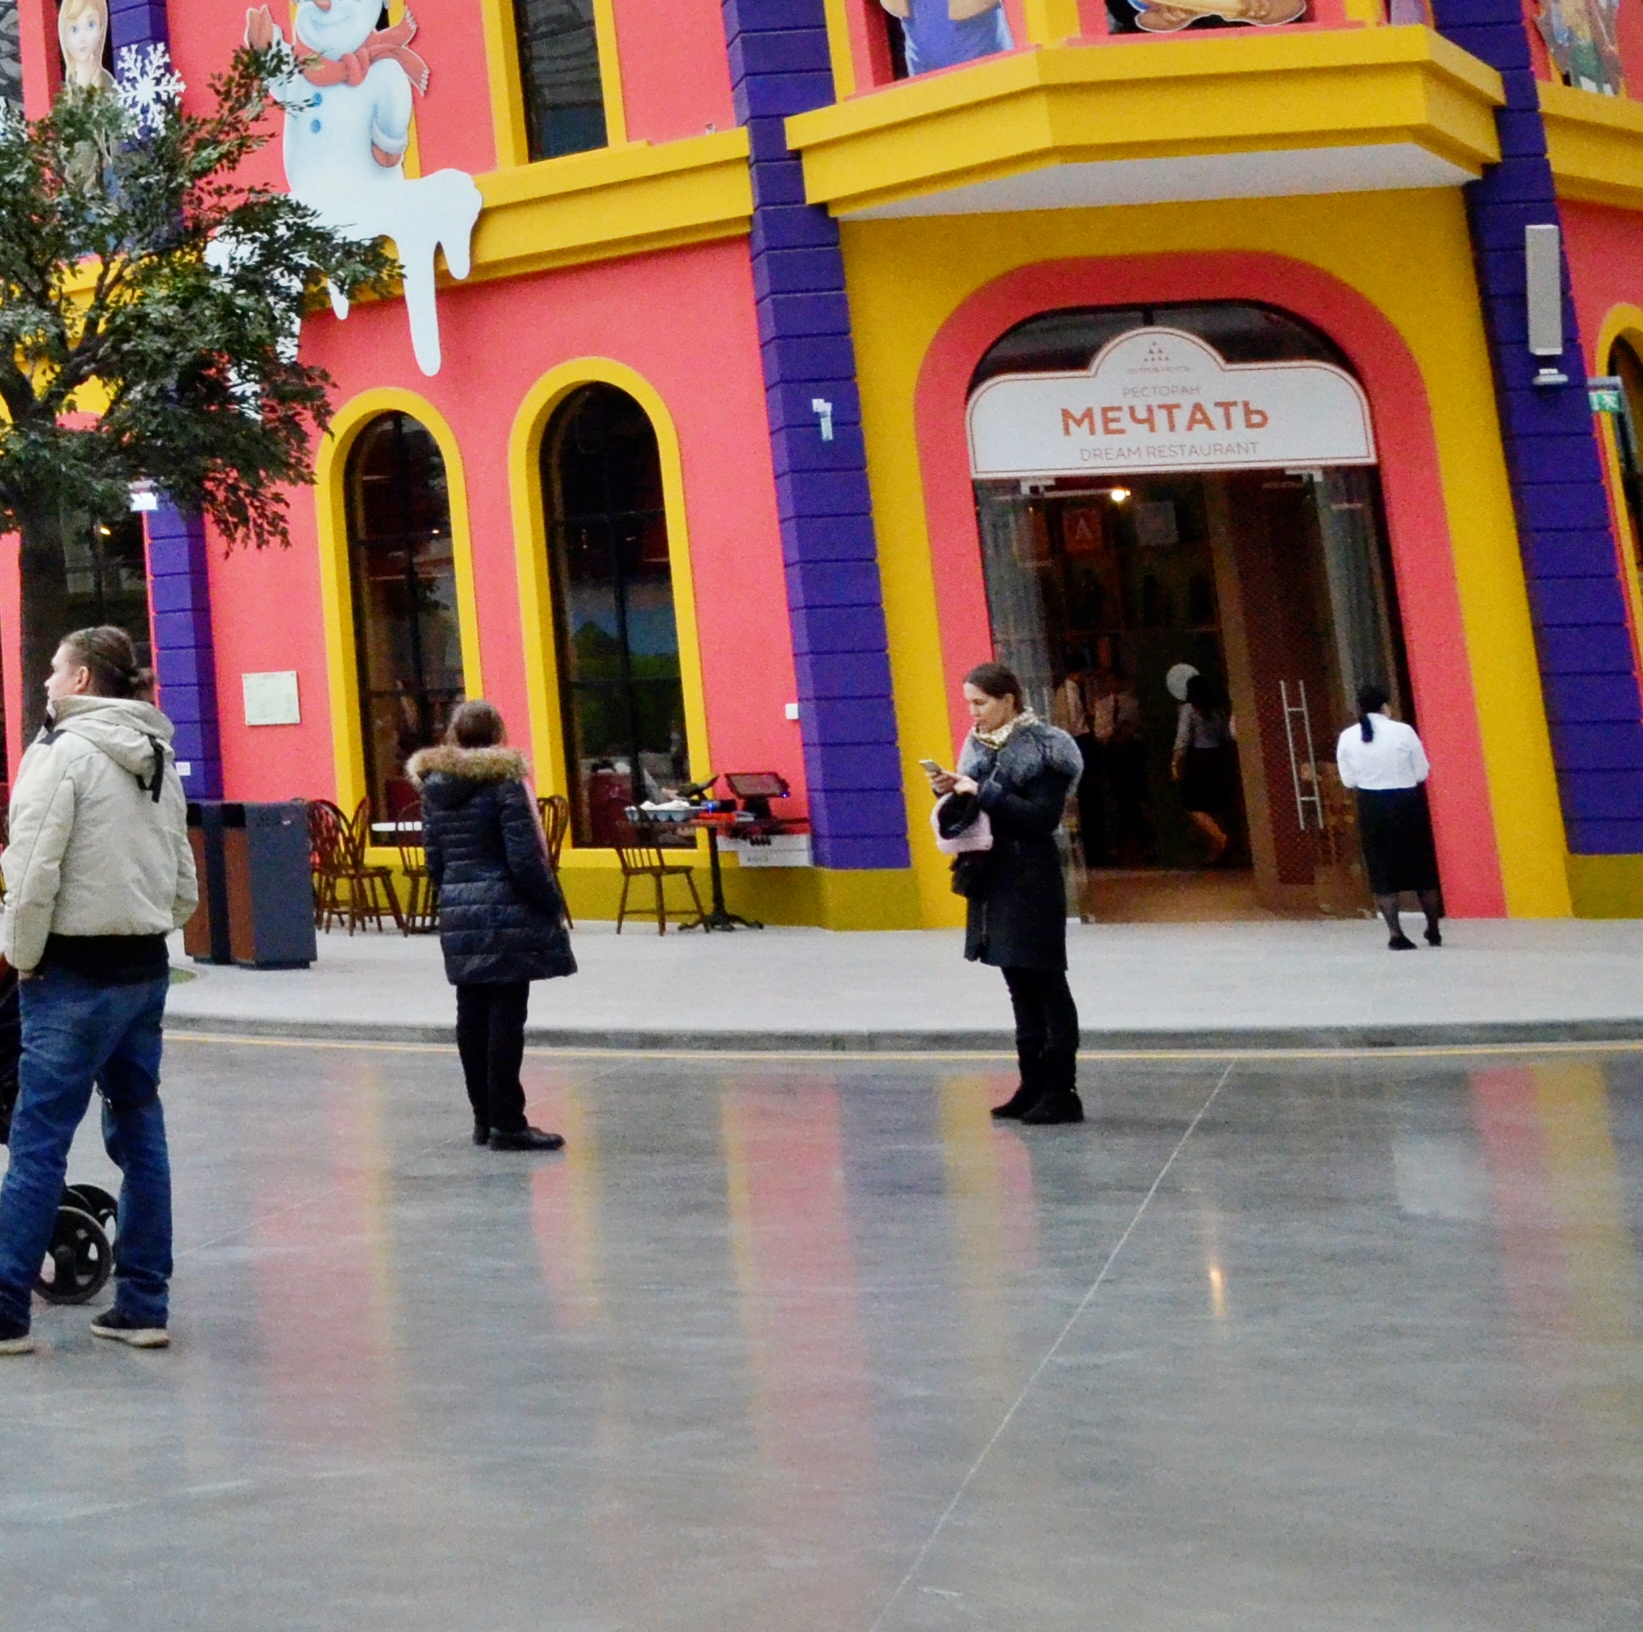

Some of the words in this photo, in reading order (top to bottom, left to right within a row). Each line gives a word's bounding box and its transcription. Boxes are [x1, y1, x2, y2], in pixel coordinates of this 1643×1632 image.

[1122, 384, 1203, 399] РЕСТОРАН
[1060, 400, 1270, 437] МЕЧТАТЬ
[1080, 445, 1143, 462] DREAM
[1146, 441, 1260, 459] RESTAURANT
